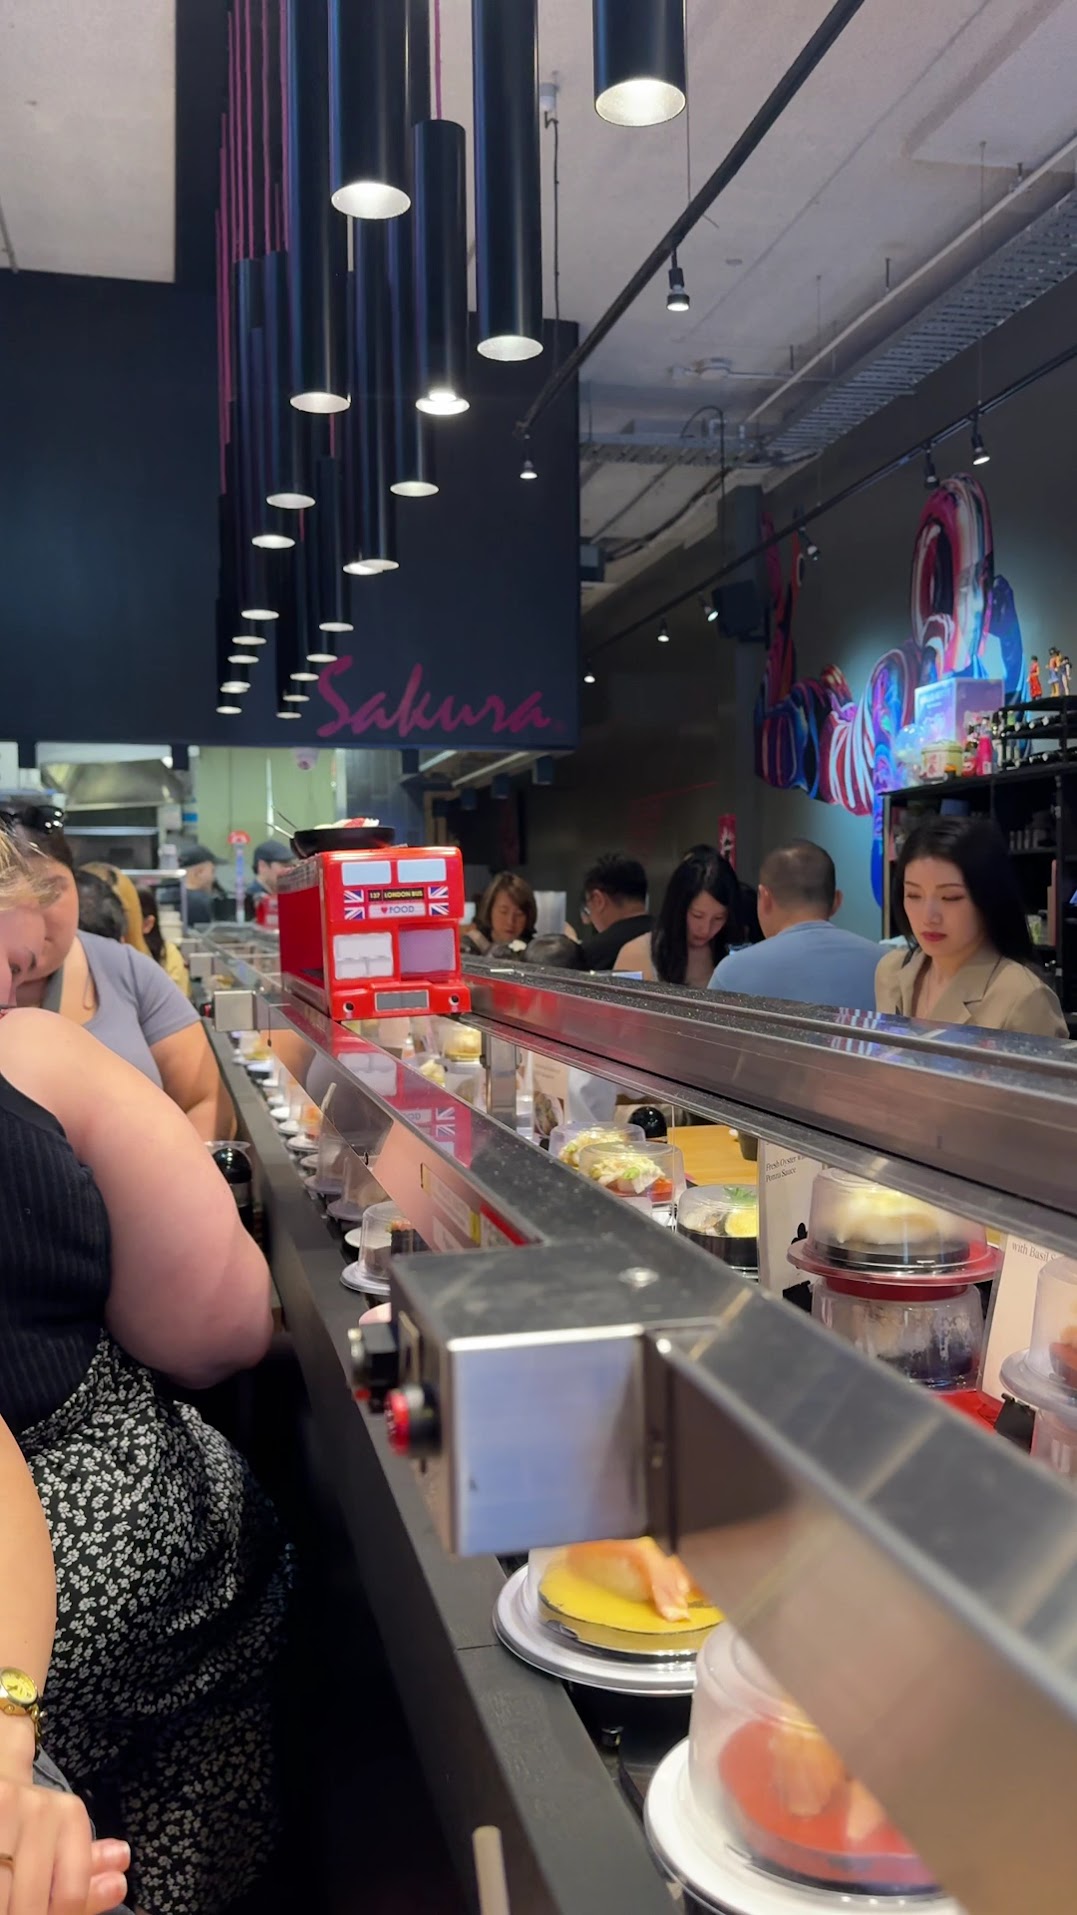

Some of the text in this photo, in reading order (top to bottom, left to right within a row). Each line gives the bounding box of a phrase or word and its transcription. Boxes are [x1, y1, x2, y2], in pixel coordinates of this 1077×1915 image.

[317, 655, 551, 738] Sakura
[389, 905, 415, 914] FOOD
[766, 1160, 780, 1171] Fresh
[780, 1156, 797, 1167] Oyster
[781, 1167, 797, 1178] Sauce
[1011, 1242, 1028, 1255] with
[1029, 1246, 1049, 1262] Basil
